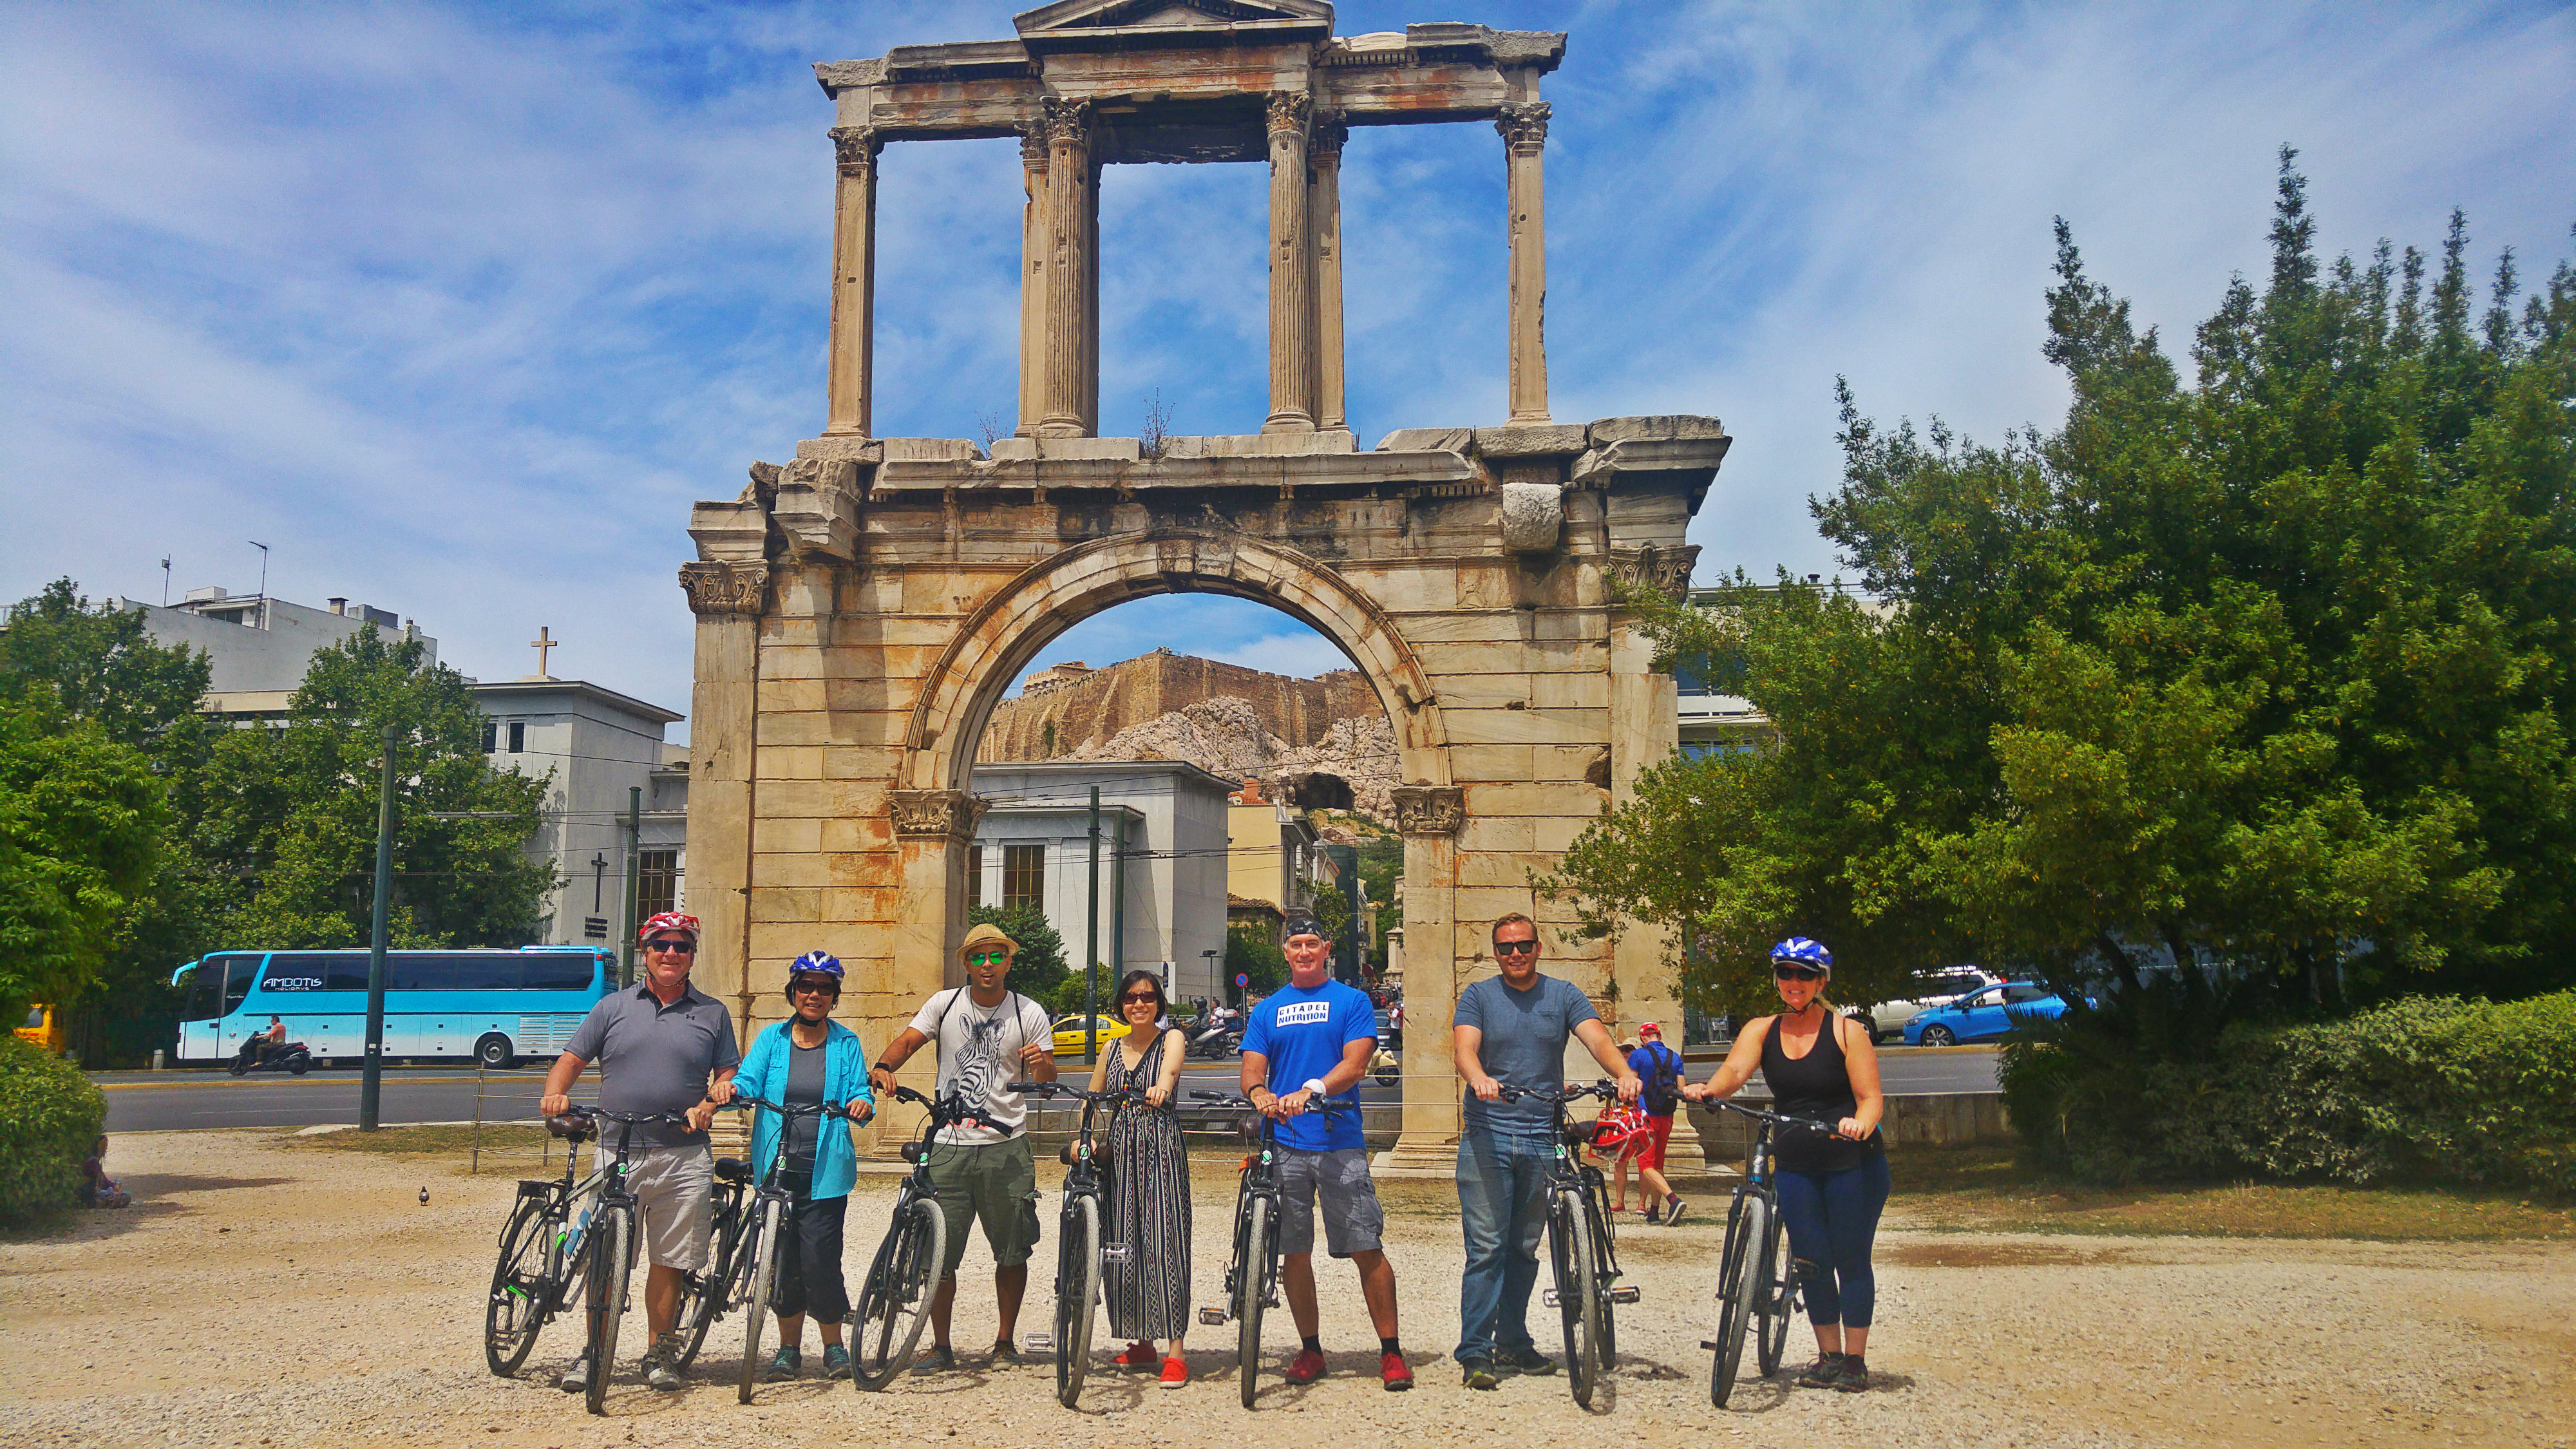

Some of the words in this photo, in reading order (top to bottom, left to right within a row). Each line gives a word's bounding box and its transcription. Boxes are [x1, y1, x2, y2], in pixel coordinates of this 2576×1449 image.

[263, 978, 322, 987] AMBOTIS
[1279, 1004, 1327, 1016] CITADEL
[1279, 1012, 1327, 1024] NUTRITION
